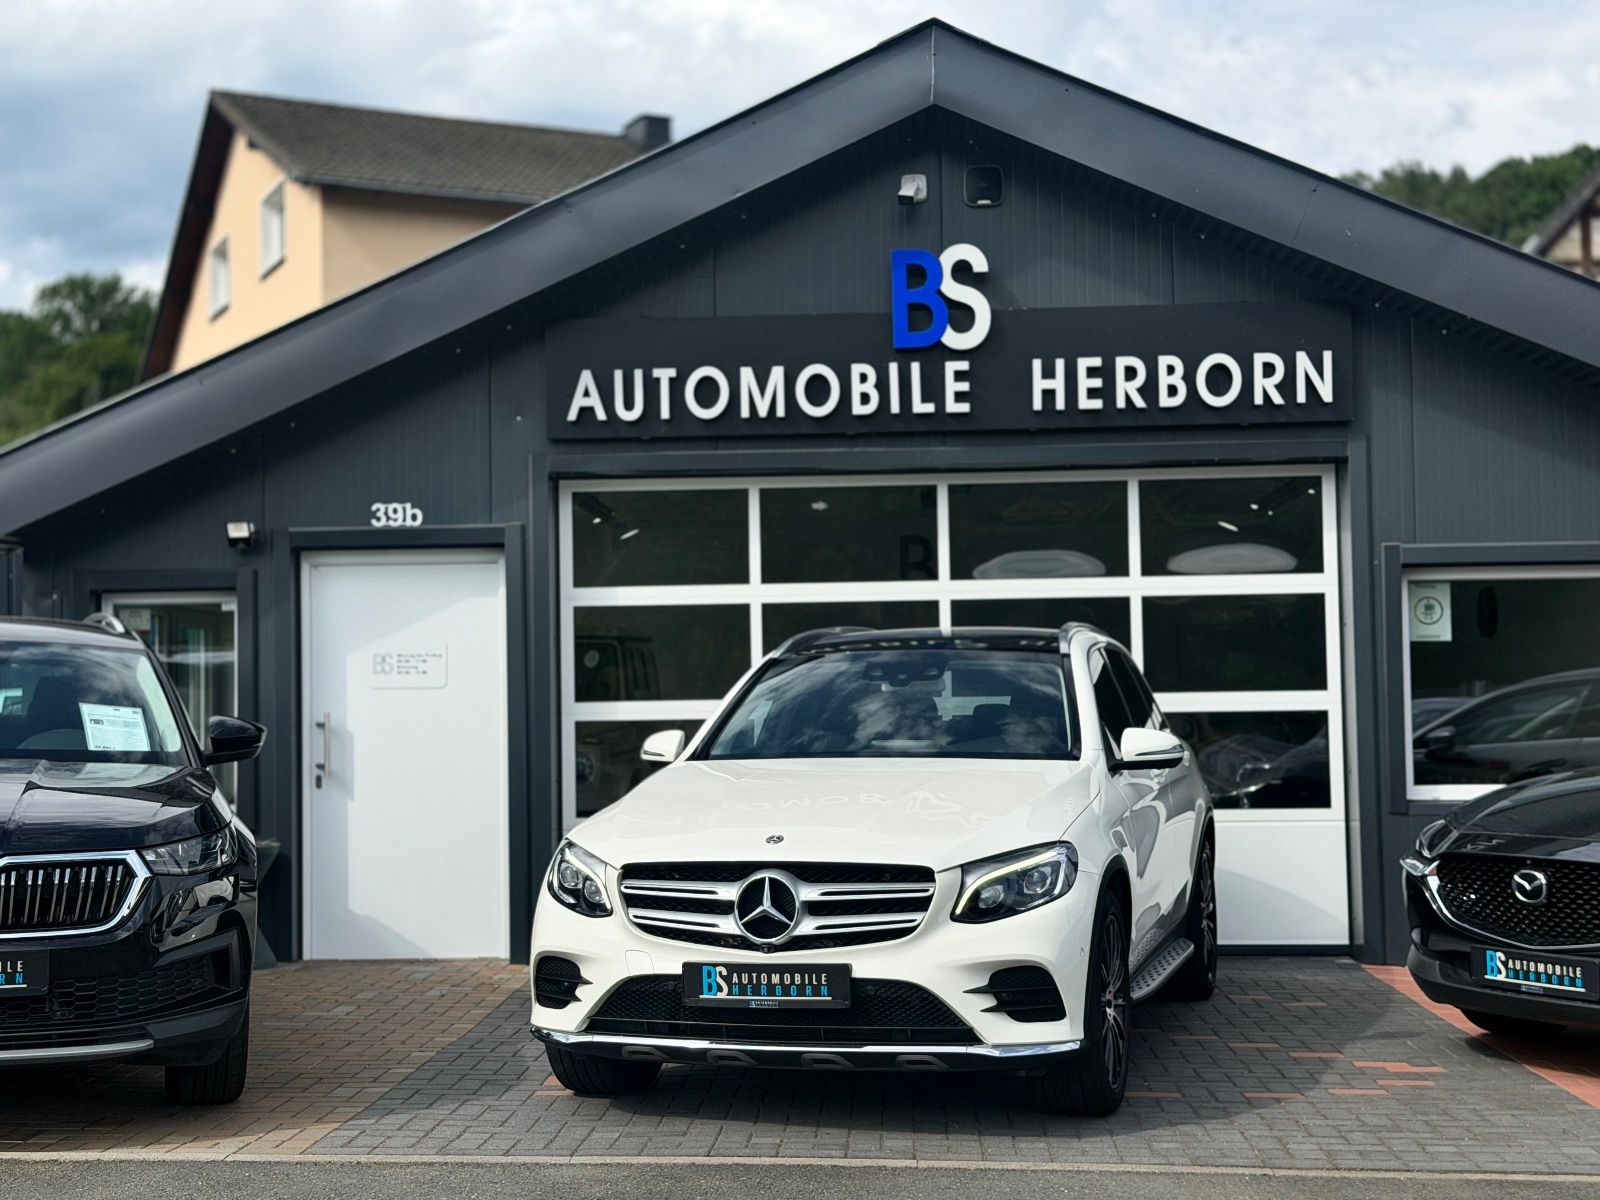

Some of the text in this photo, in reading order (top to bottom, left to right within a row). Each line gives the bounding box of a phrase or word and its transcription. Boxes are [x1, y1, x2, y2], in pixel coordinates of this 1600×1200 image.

[891, 243, 992, 351] BS
[566, 350, 1334, 422] AUTOMOBILE HERBORN
[370, 502, 423, 527] 39b
[1486, 950, 1507, 978] BS
[1508, 959, 1582, 977] AUTOMOBILE
[702, 965, 729, 997] BS
[732, 973, 828, 985] AUTOMOBILE
[732, 985, 828, 996] HERBORN
[1508, 970, 1583, 987] HERBORN
